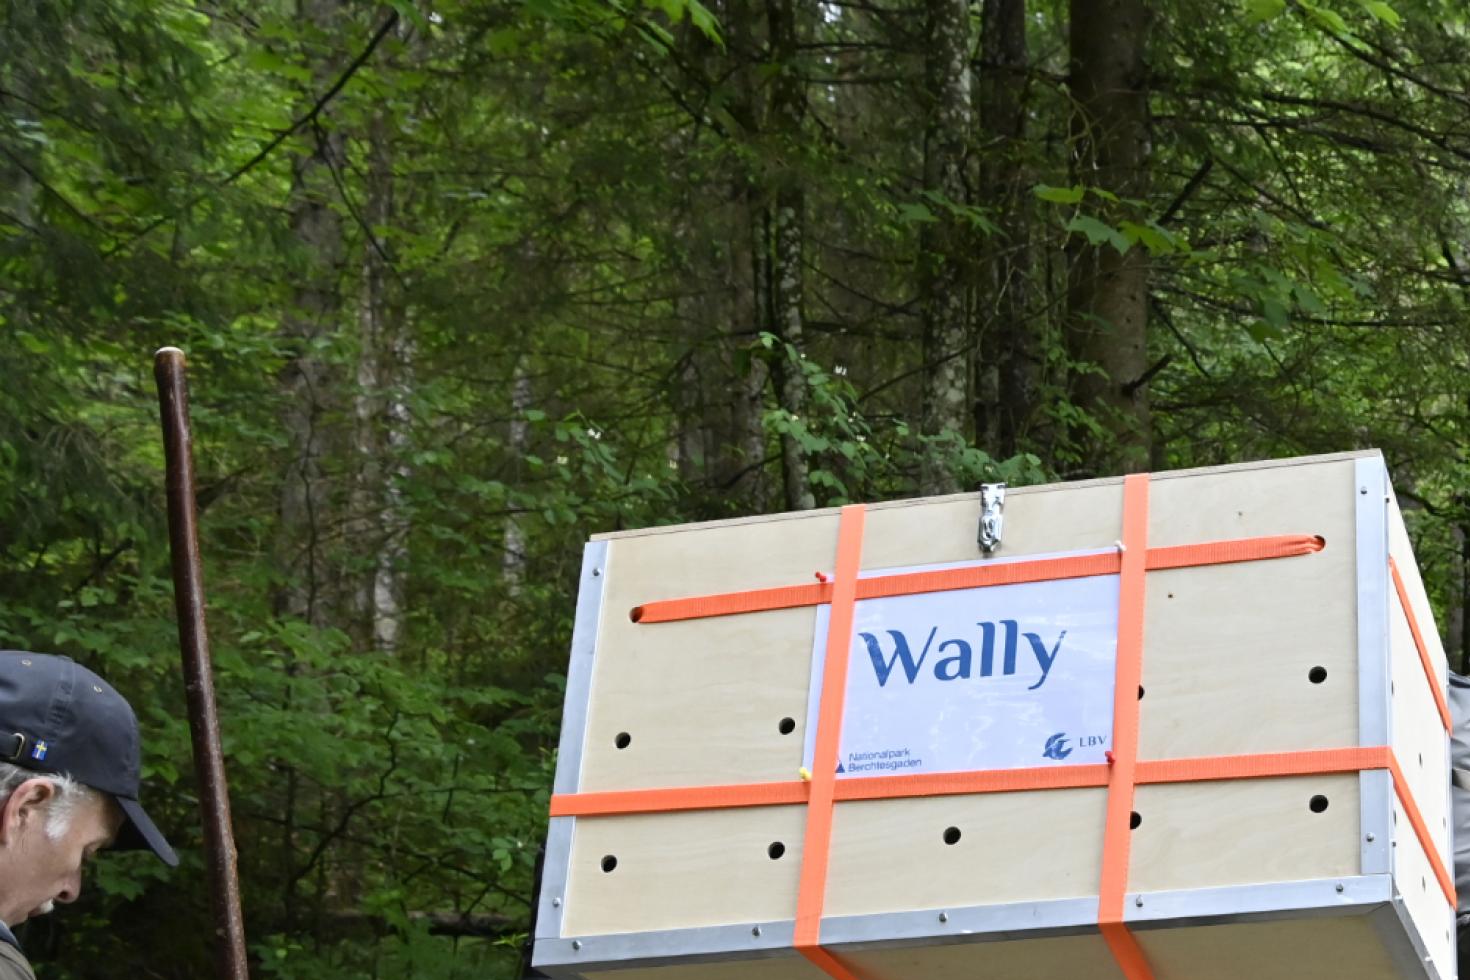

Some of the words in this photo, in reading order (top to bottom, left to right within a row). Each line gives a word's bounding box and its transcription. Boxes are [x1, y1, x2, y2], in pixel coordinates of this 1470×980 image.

[858, 619, 1067, 690] Wally
[1079, 735, 1107, 748] LBV
[848, 747, 911, 761] Nationalpark
[848, 759, 922, 772] Berchtesgaden
